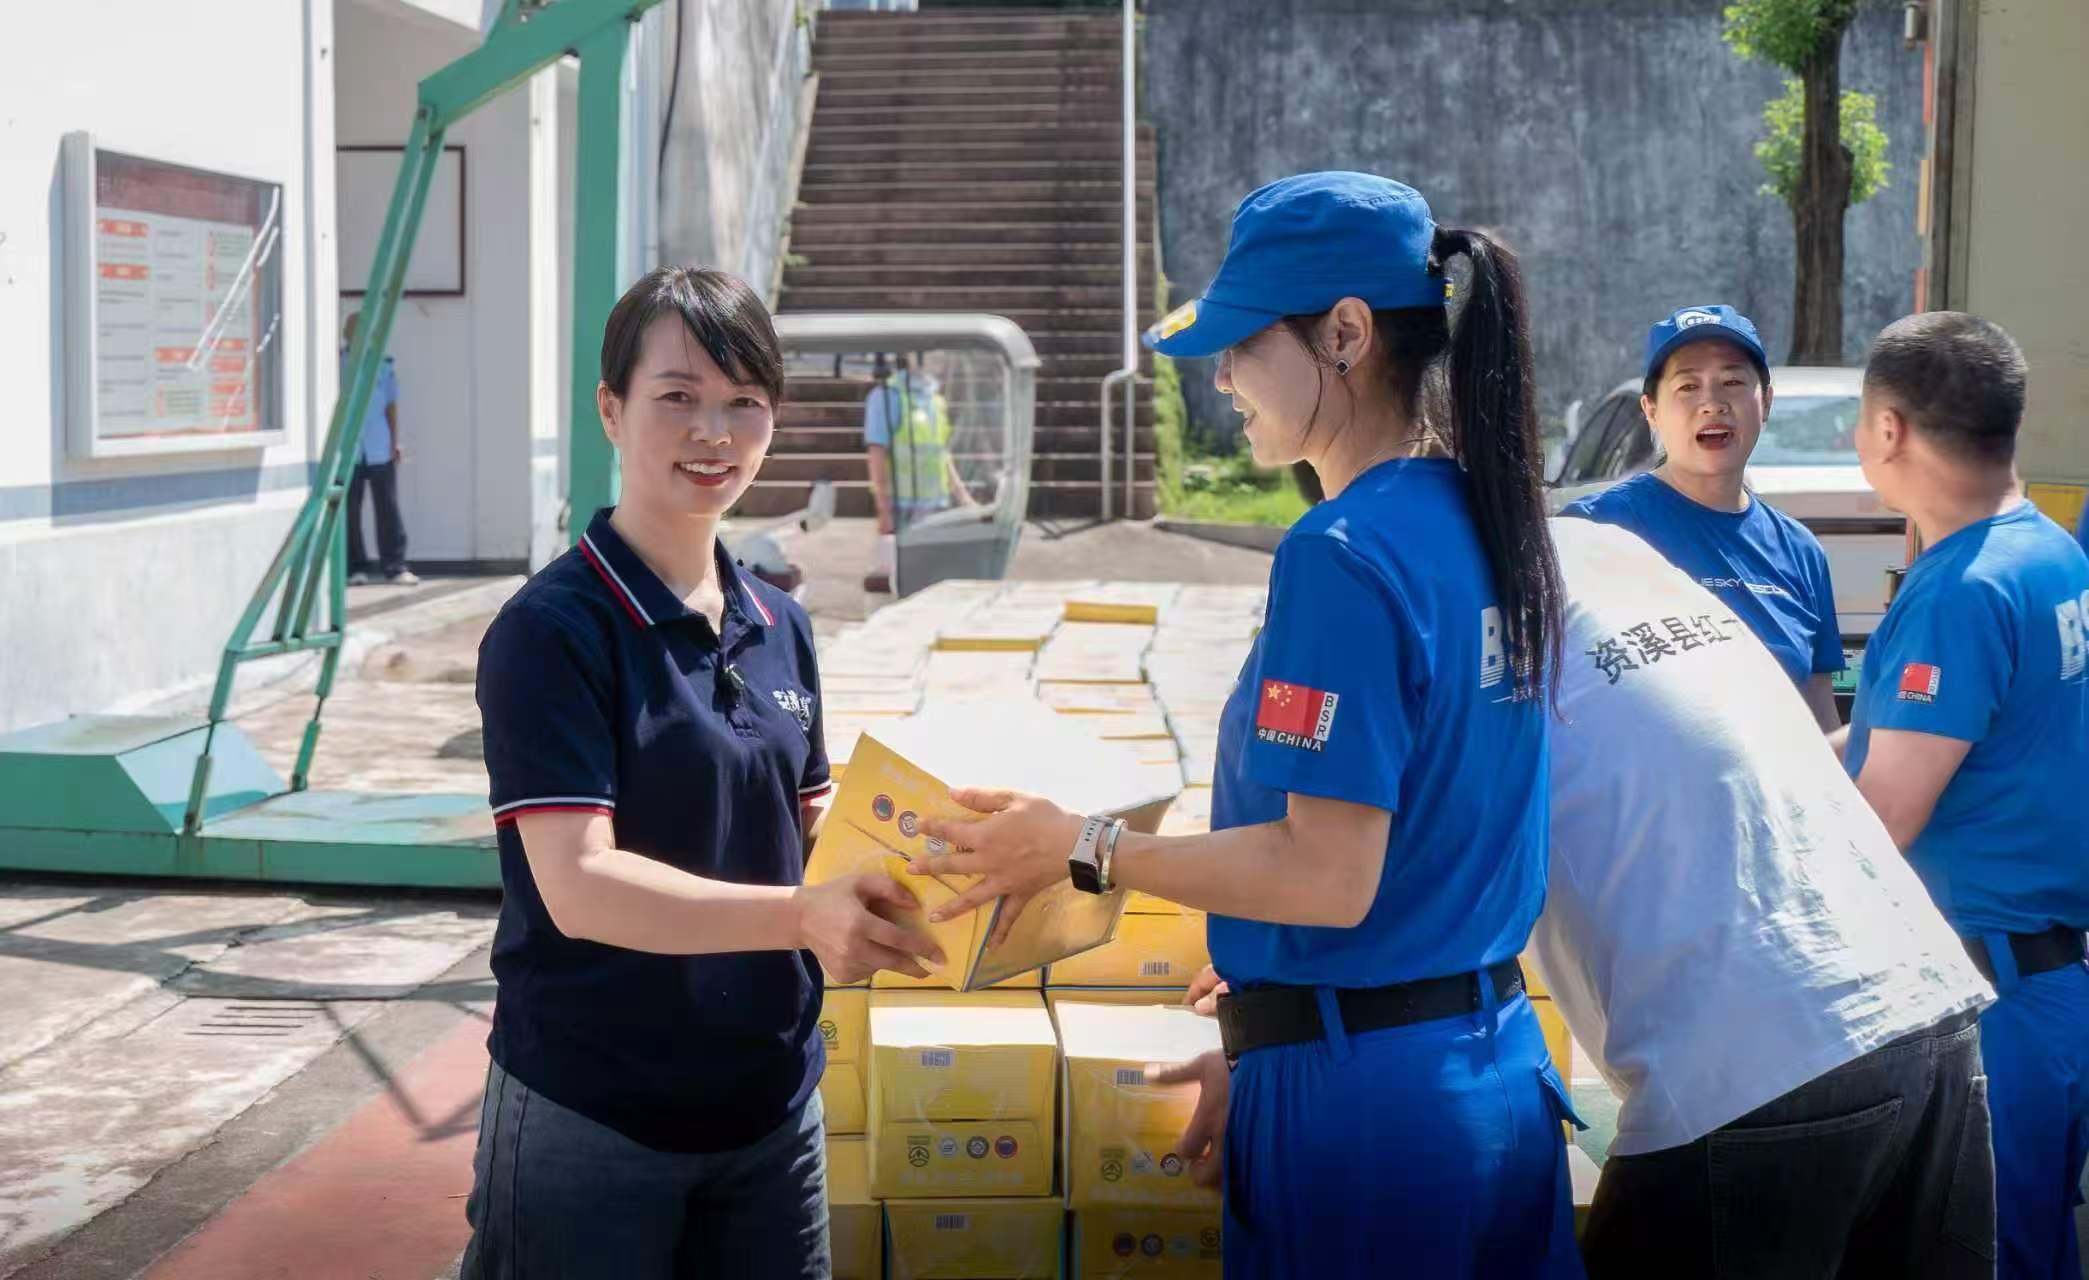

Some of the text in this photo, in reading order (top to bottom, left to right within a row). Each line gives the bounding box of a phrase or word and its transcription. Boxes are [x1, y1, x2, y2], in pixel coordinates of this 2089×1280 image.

[1317, 695, 1335, 738] BSR
[1258, 727, 1322, 752] 中国 CHINA
